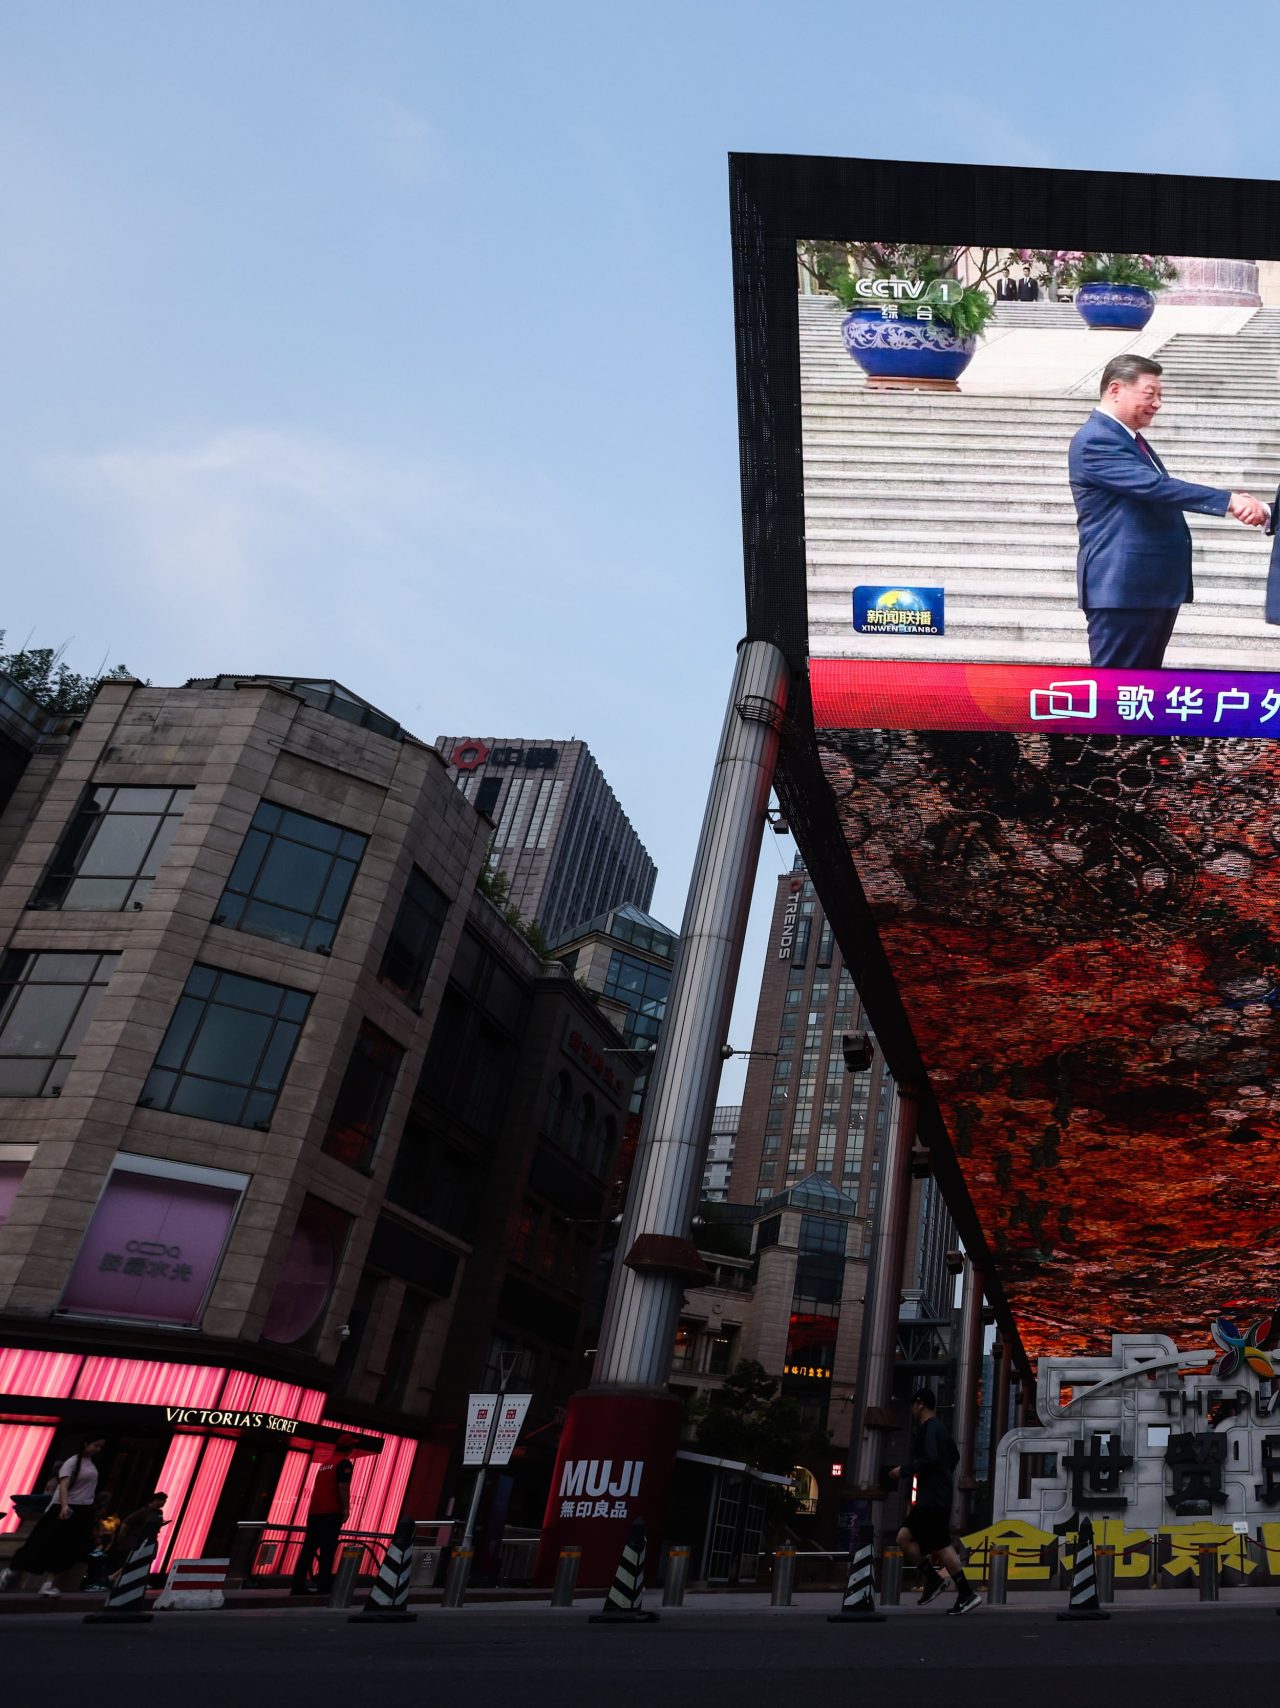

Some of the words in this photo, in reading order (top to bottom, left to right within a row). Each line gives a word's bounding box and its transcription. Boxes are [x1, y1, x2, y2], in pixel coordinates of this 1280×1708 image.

[855, 279, 925, 299] CCTV
[940, 284, 948, 301] 1
[881, 304, 933, 321] 综合
[867, 610, 931, 625] 新闻联播
[779, 892, 800, 959] TRENDS
[1160, 1389, 1222, 1416] THE
[166, 1407, 263, 1428] VICTORIA'S
[266, 1415, 298, 1434] SECRET
[559, 1459, 644, 1497] MUJI
[559, 1499, 628, 1519] 無印良品
